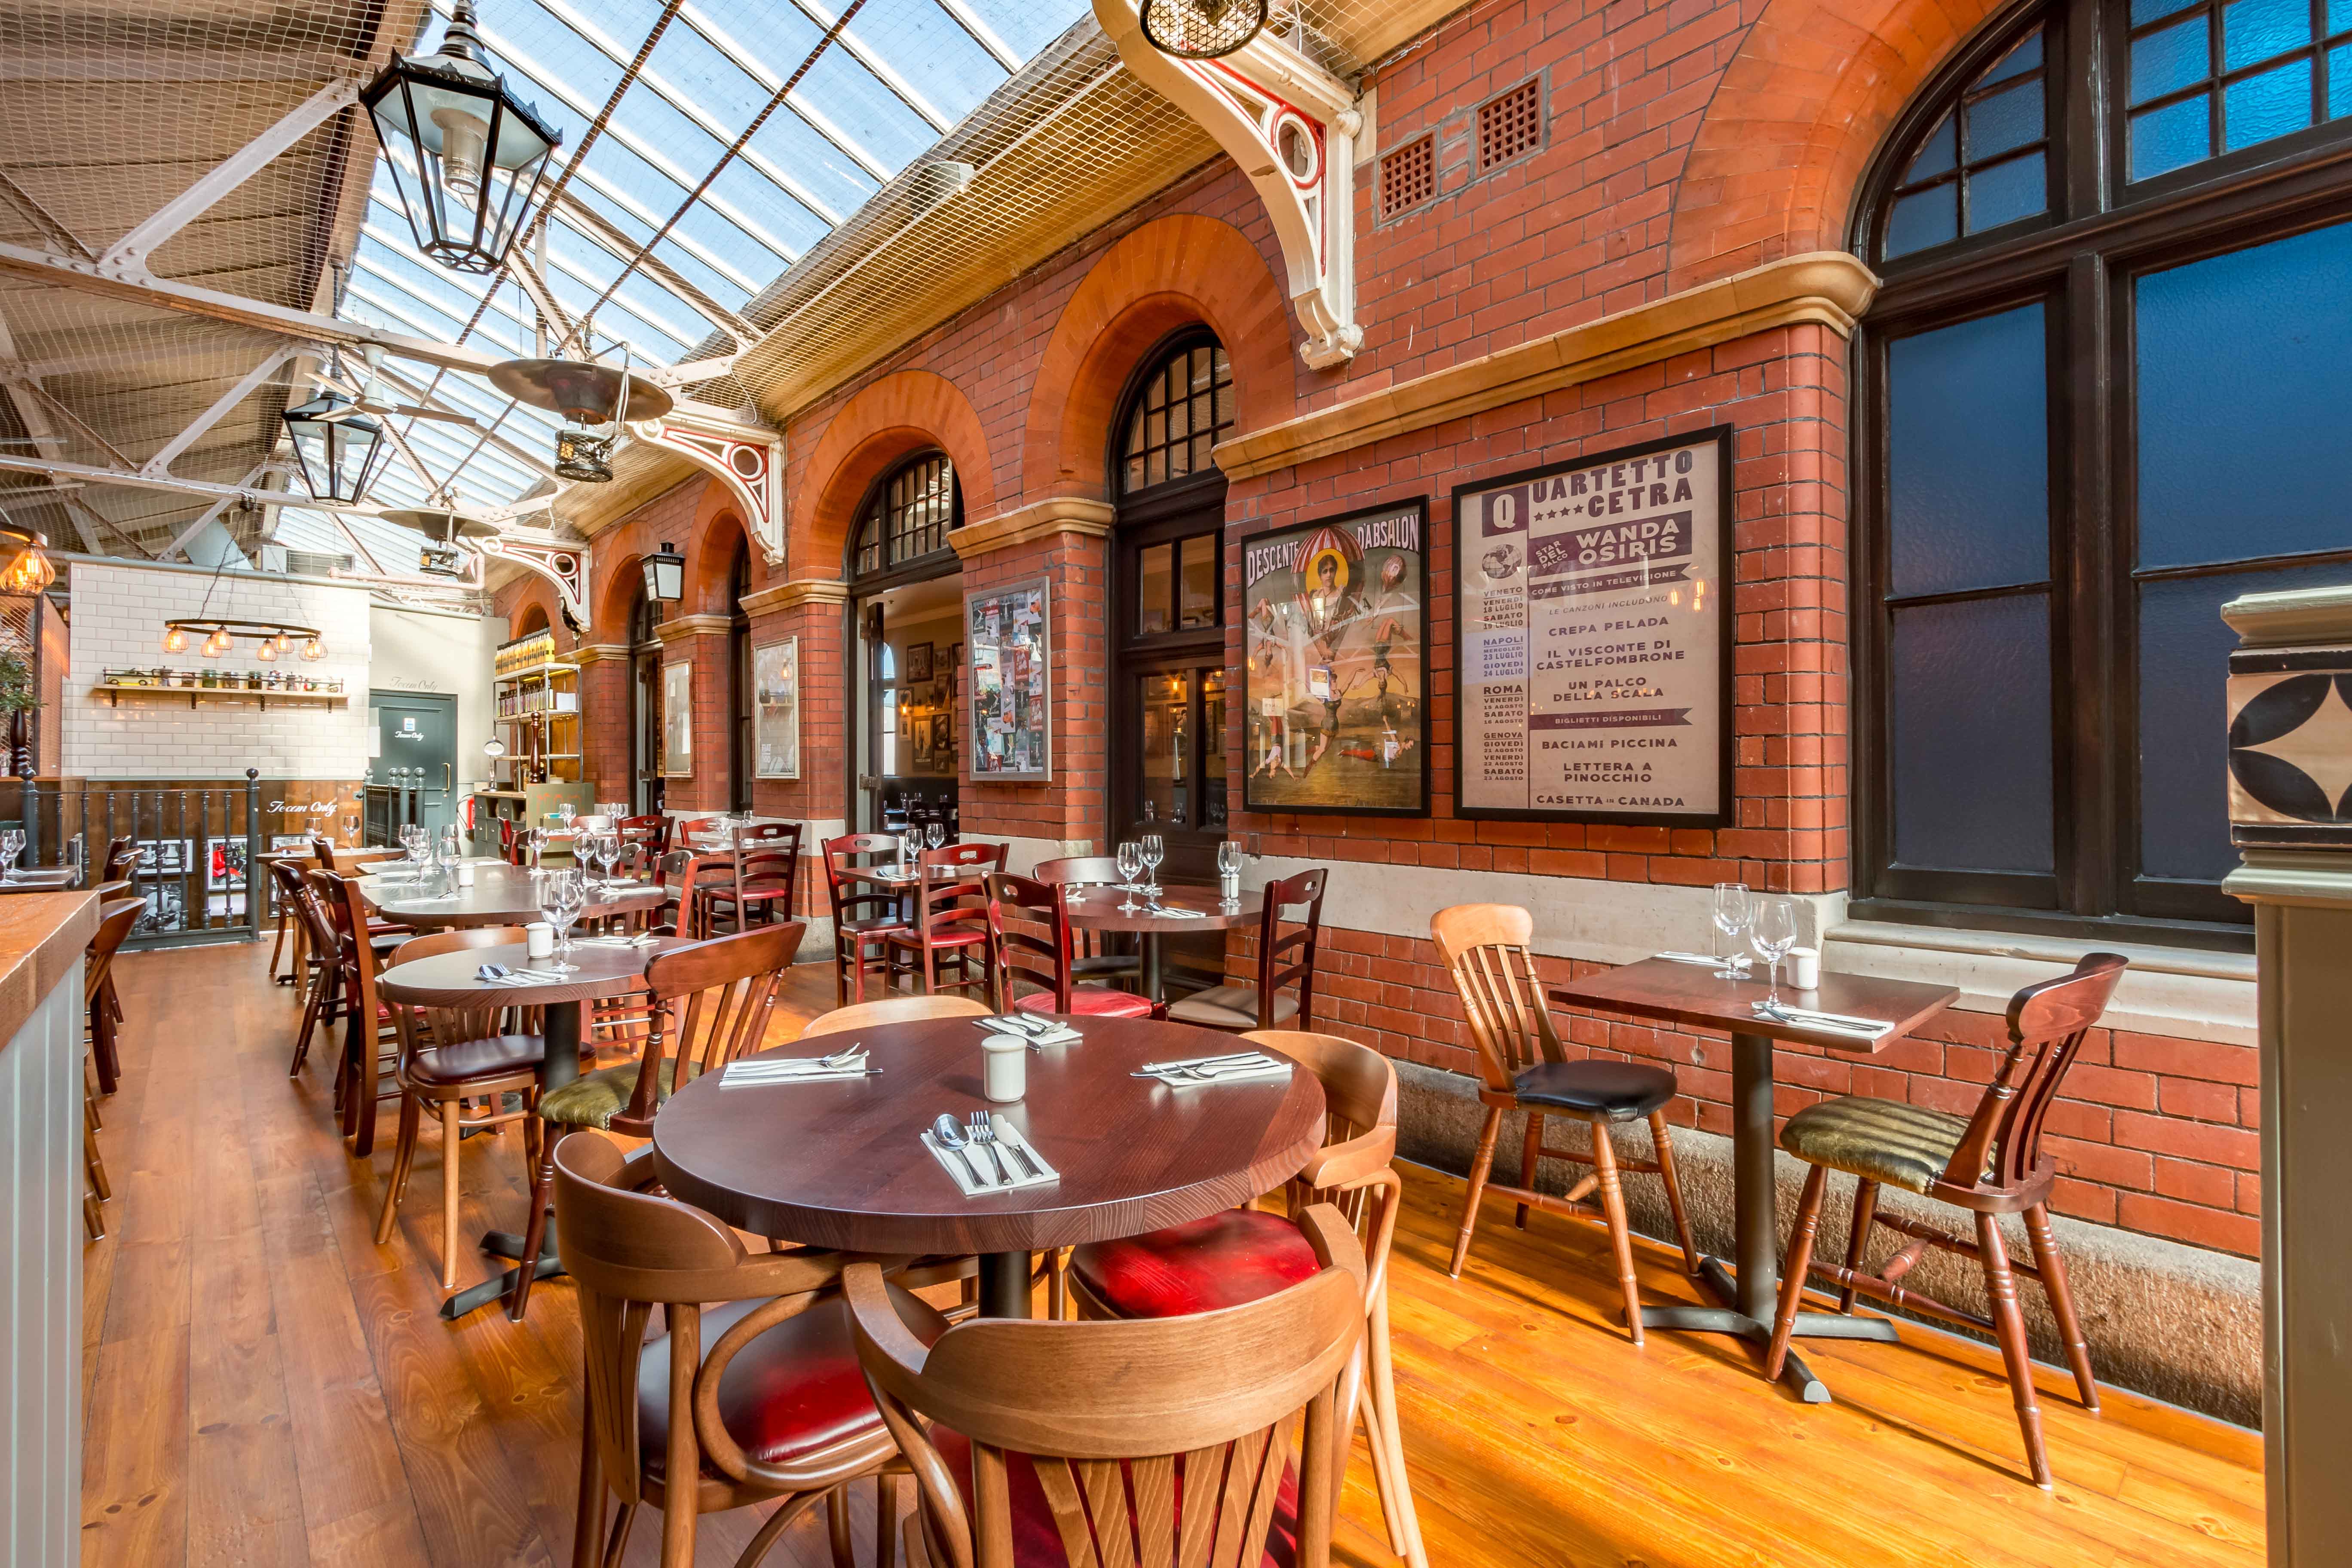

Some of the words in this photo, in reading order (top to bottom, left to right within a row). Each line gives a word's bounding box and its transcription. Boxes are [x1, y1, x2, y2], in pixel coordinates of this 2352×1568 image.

[1588, 478, 1693, 518] CETRA
[1357, 513, 1419, 554] D'ABSALON
[1576, 519, 1680, 549] WANDA
[1536, 540, 1561, 557] STAR
[1578, 536, 1677, 565] OSIRIS
[1539, 548, 1565, 564] DEL
[1542, 553, 1568, 569] PALCO
[1246, 540, 1299, 590] DESCENTE
[1531, 587, 1558, 595] COME
[1561, 582, 1589, 592] VISTO
[1607, 570, 1676, 585] TELEVISIONE
[1484, 586, 1522, 597] VENETO
[1495, 603, 1523, 612] LUGLIO
[1563, 603, 1605, 614] CANZONI
[1608, 595, 1668, 608] INCLUDONO
[1484, 612, 1523, 622] SABATO
[1495, 619, 1523, 628] LUGLIO
[1548, 624, 1597, 637] CREPA
[1604, 616, 1669, 631] PELADA
[1483, 636, 1523, 646] NAPOLI
[1495, 651, 1523, 659] LUGLIO
[1548, 650, 1561, 658] IL
[1568, 642, 1646, 657] VISCONTE
[1654, 640, 1670, 649] DI
[1536, 650, 1685, 671] CASTELFOMBRONE
[418, 680, 438, 692] Only
[1483, 684, 1523, 695] ROMA
[1568, 681, 1588, 690] UN
[1595, 677, 1647, 688] PALCO
[1553, 692, 1602, 702] DELLA
[1611, 688, 1664, 699] SCALA
[1602, 714, 1661, 723] DISPONIBILI
[1542, 740, 1603, 749] BACIAMI
[1611, 738, 1677, 748] PICCINA
[1563, 763, 1634, 771] LETTERA
[1642, 762, 1652, 771] A
[1564, 773, 1651, 783] PINOCCHIO
[266, 800, 308, 813] Team
[310, 797, 338, 817] Only
[1536, 795, 1603, 805] CASETTA
[1618, 796, 1685, 806] CANADA
